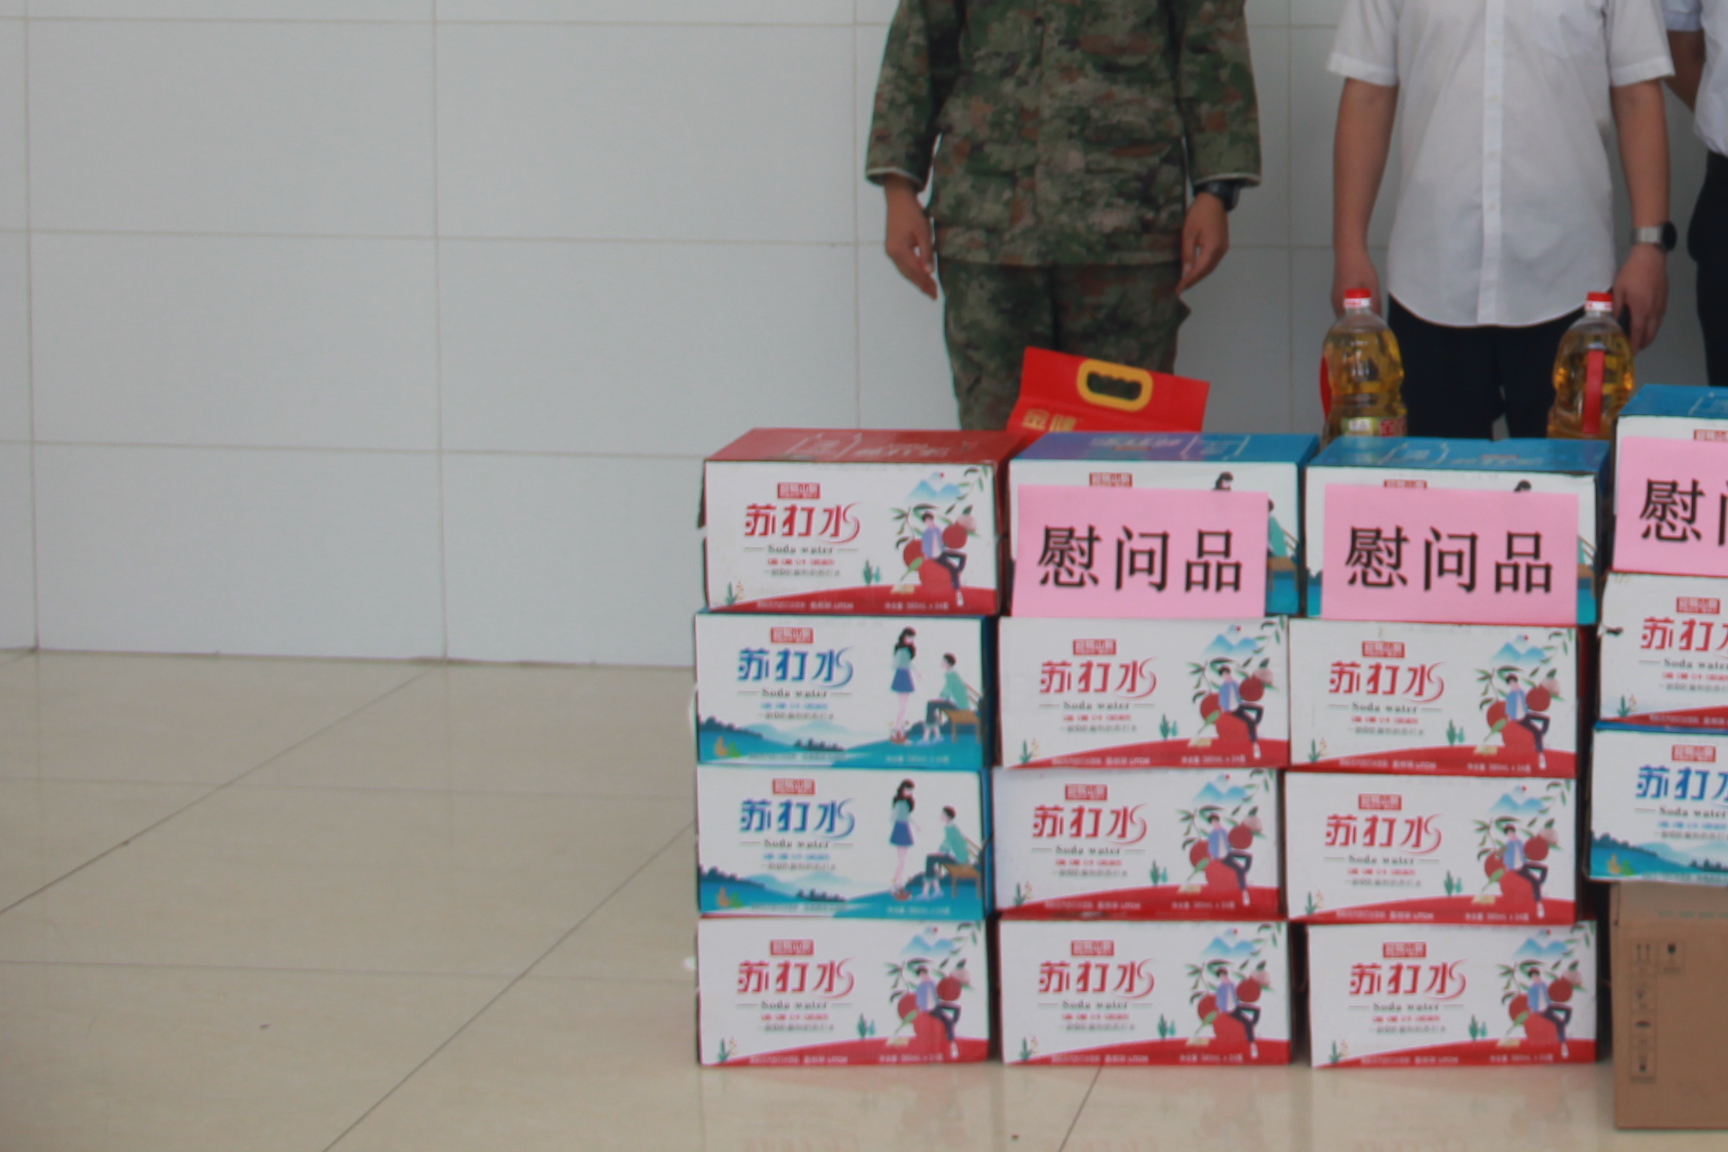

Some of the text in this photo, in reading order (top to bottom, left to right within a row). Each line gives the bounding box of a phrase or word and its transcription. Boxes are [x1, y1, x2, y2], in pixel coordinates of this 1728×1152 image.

[744, 502, 861, 545] 苏打水
[1037, 524, 1242, 593] 慰问品
[1344, 524, 1554, 594] 慰问品
[737, 647, 853, 689] 苏打水
[1040, 659, 1158, 700] 苏打水
[1328, 660, 1446, 703] 苏打水
[739, 799, 855, 840] 苏打水
[1032, 804, 1149, 845] 苏打水
[1324, 813, 1443, 855] 苏打水
[736, 958, 855, 999] 苏打水
[1037, 959, 1155, 999] 苏打水
[1349, 960, 1467, 1001] 苏打水
